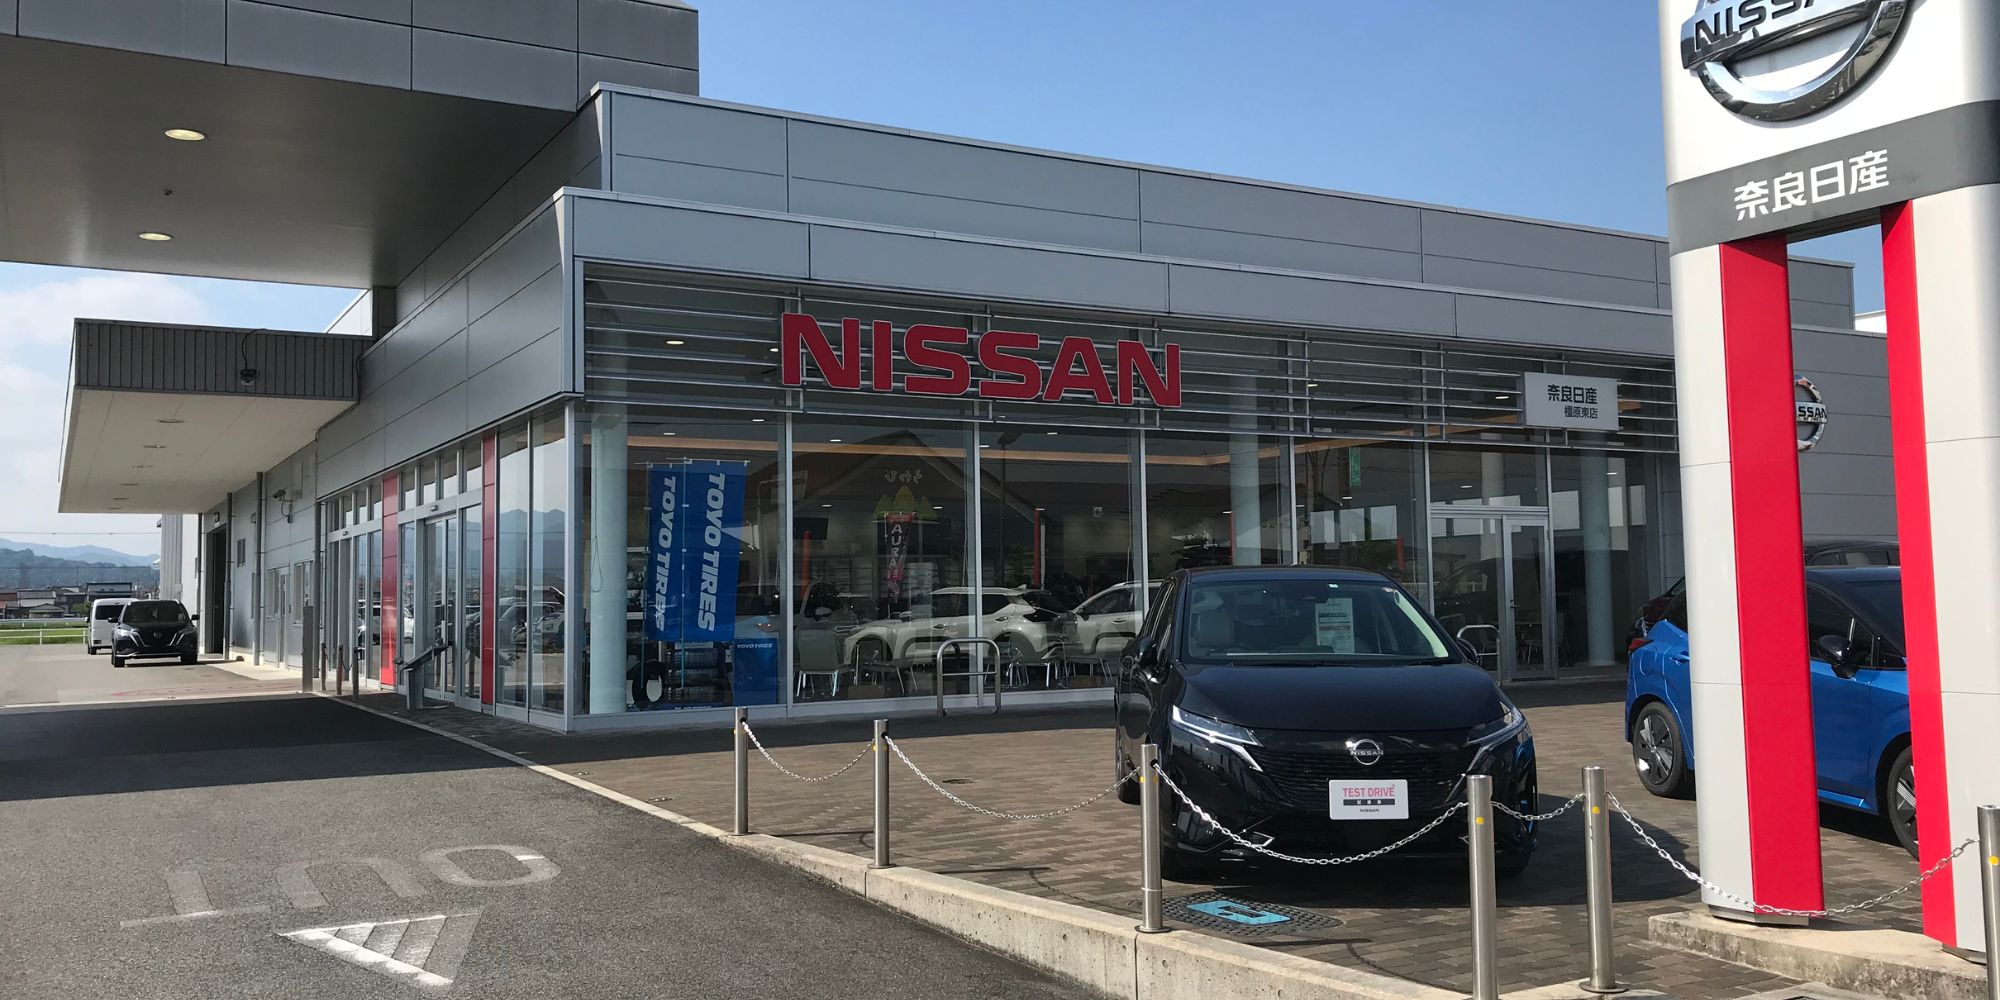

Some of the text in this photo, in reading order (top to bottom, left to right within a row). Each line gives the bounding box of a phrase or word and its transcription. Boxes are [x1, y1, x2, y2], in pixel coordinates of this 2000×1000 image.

[1694, 0, 1814, 52] NISS
[1734, 149, 1889, 221] 奈良日産
[781, 312, 1181, 408] NISSAN
[1547, 383, 1598, 405] 奈良日産
[1797, 405, 1827, 419] SSAN
[658, 475, 676, 549] TOYO
[697, 472, 726, 632] TOYO TIRES
[888, 524, 903, 569] AURA
[1343, 787, 1395, 797] TEST DRIVE
[98, 845, 562, 928] OUT
